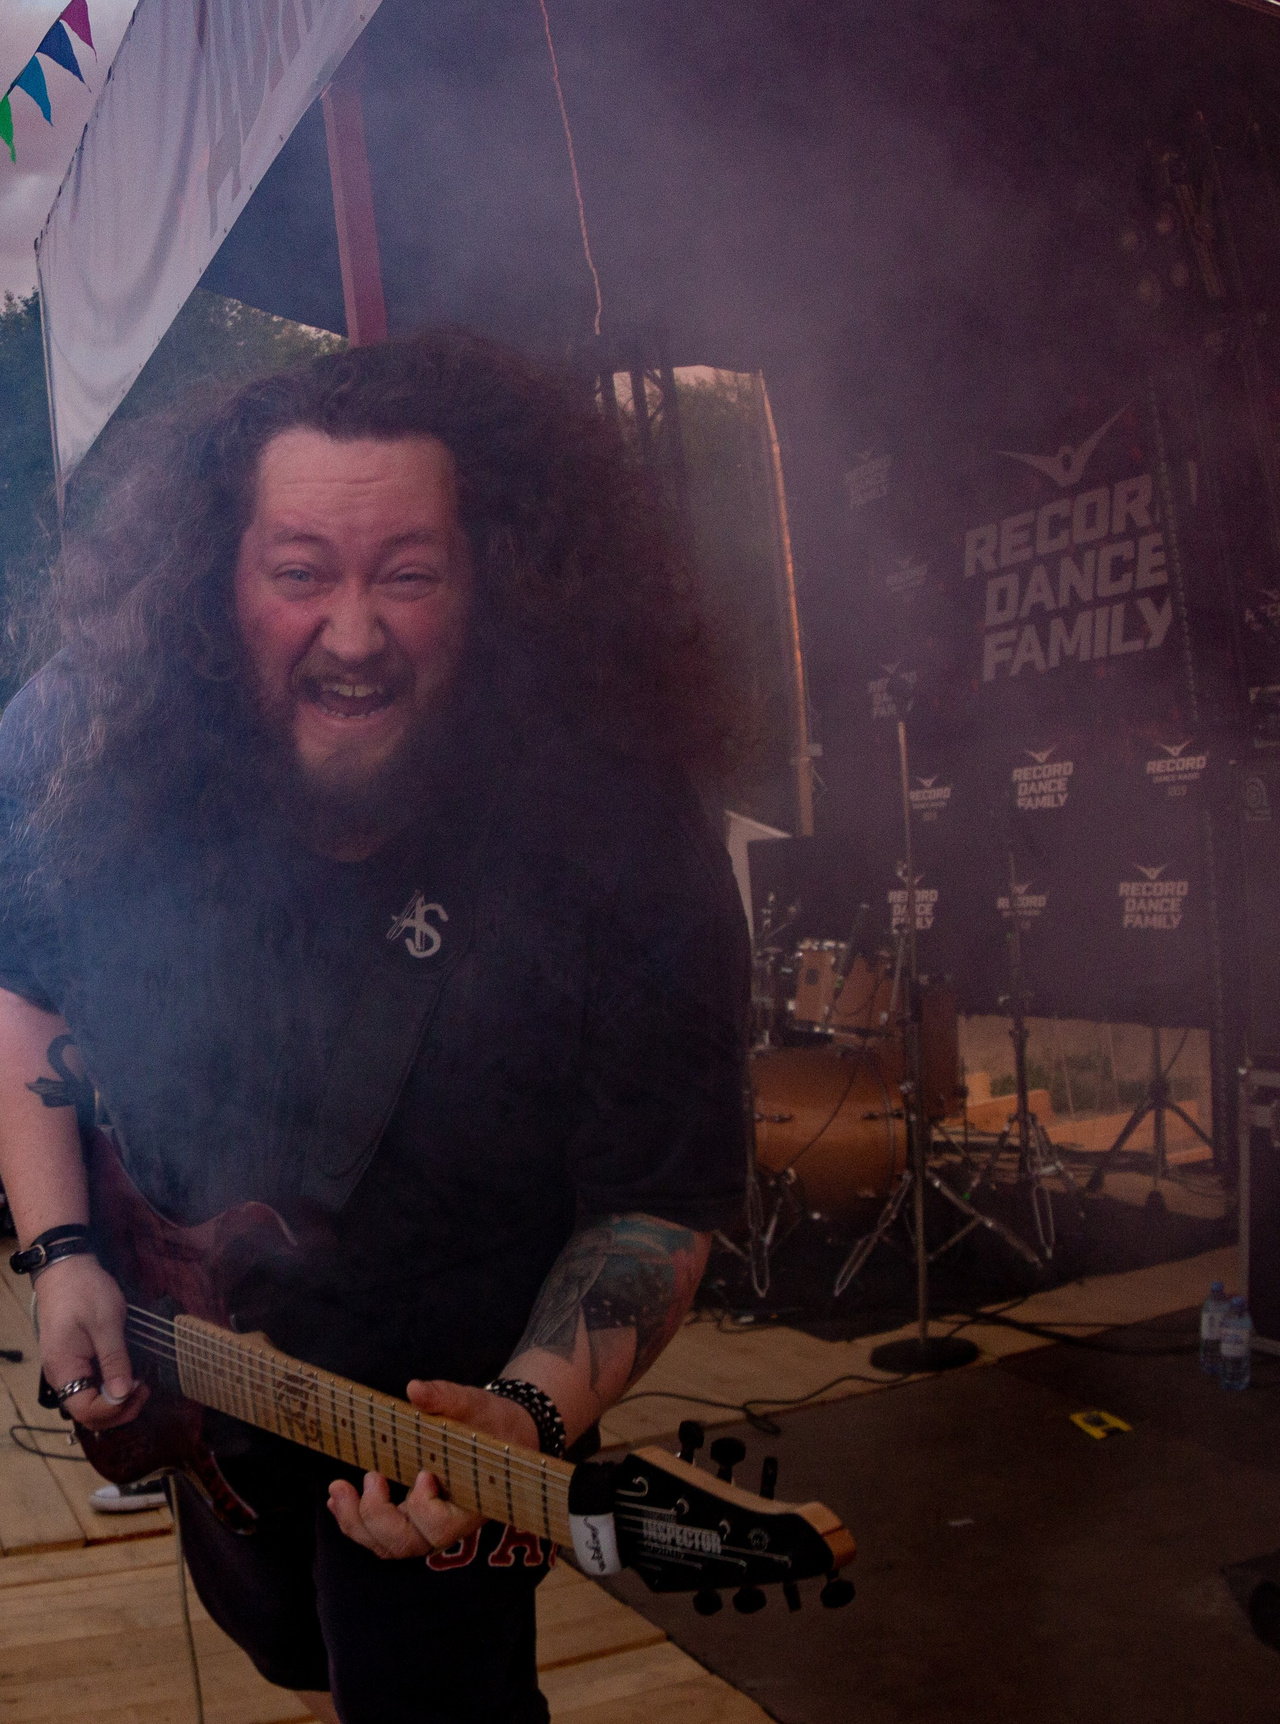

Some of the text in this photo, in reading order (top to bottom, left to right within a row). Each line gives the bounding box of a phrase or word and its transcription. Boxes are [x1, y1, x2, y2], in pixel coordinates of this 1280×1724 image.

[964, 474, 1160, 578] RECOR
[984, 532, 1170, 627] DANCE
[981, 594, 1175, 683] FAMILY
[1011, 760, 1075, 783] RECORD
[1017, 778, 1068, 796] DANCE
[1016, 793, 1069, 810] FAMILY
[1118, 881, 1189, 897] RECORD
[1124, 897, 1182, 911] DANCE
[1123, 913, 1183, 930] FAMILY
